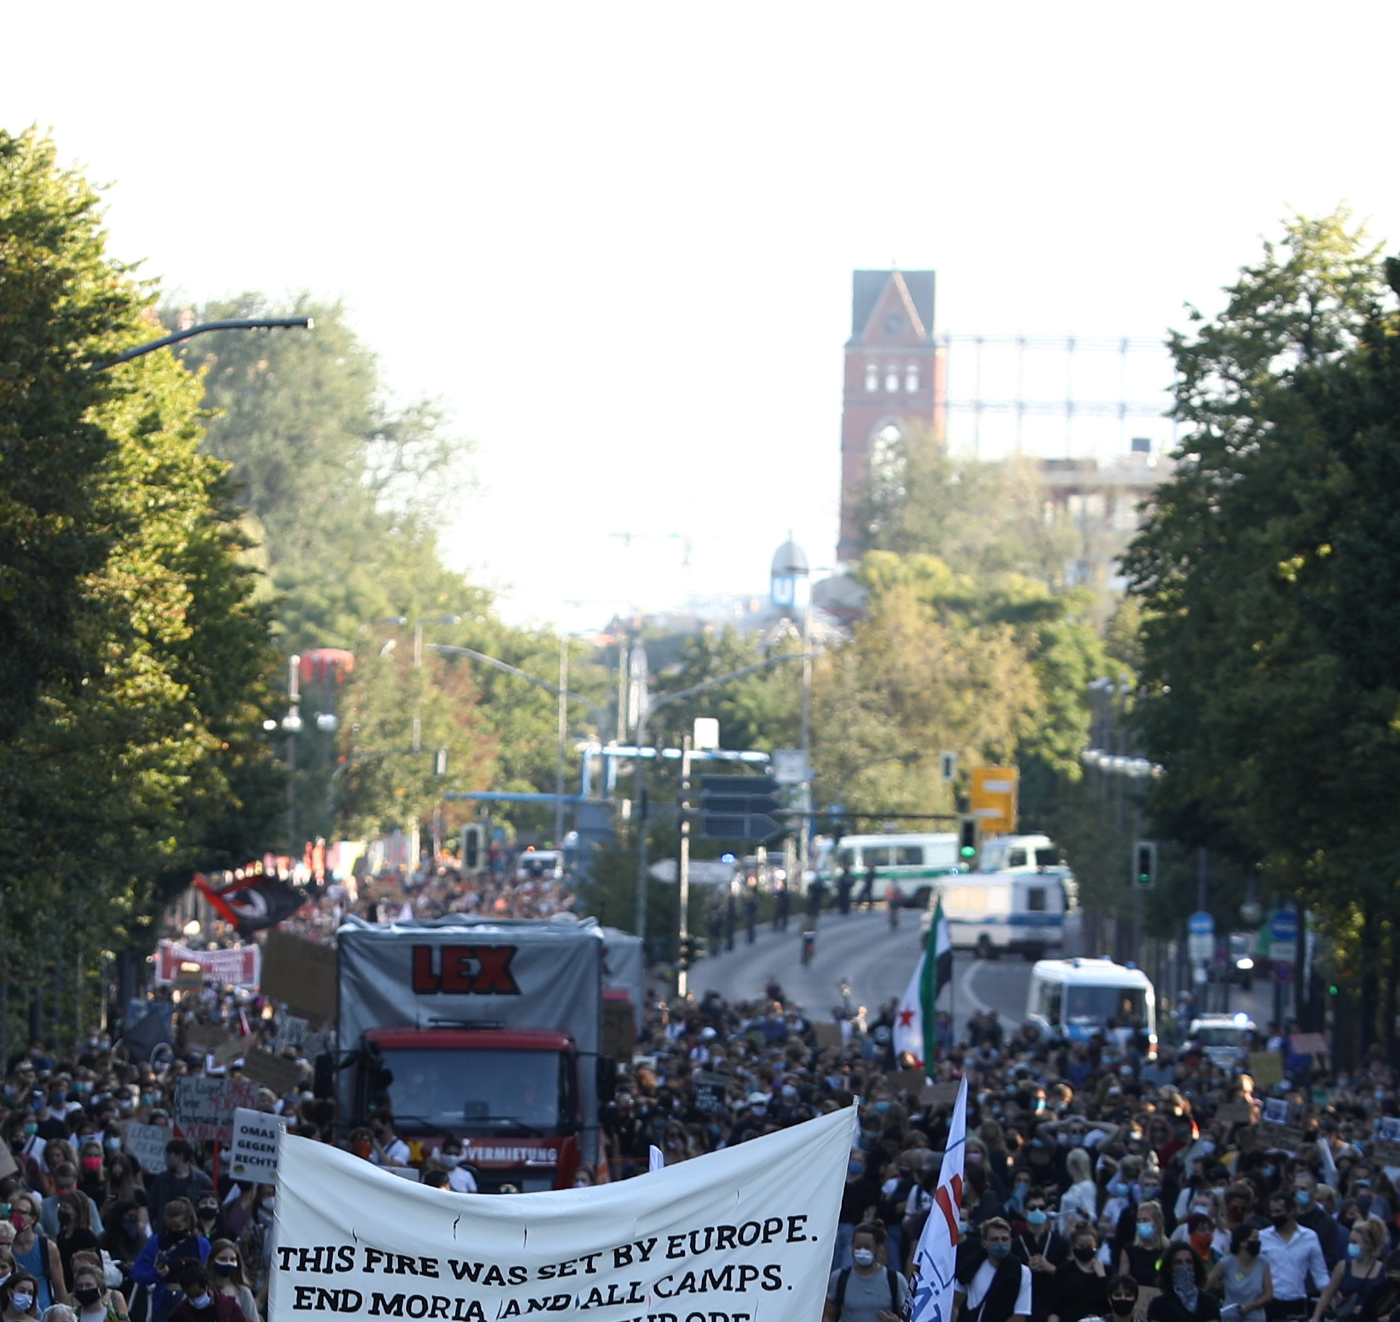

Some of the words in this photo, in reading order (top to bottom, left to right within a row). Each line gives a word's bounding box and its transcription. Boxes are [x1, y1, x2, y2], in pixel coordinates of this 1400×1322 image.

[412, 944, 522, 994] LEX
[237, 1139, 276, 1153] GEGEN
[239, 1125, 276, 1139] OMAS
[277, 1246, 355, 1274] THIS
[362, 1247, 440, 1278] FIRE
[447, 1259, 528, 1286] WAS
[536, 1252, 602, 1280] SET
[611, 1238, 658, 1268] BY
[666, 1215, 818, 1259] EUROPE.
[292, 1286, 363, 1313] END
[500, 1293, 572, 1319] AND
[580, 1281, 646, 1310] ALL
[653, 1264, 792, 1298] CAMPS.
